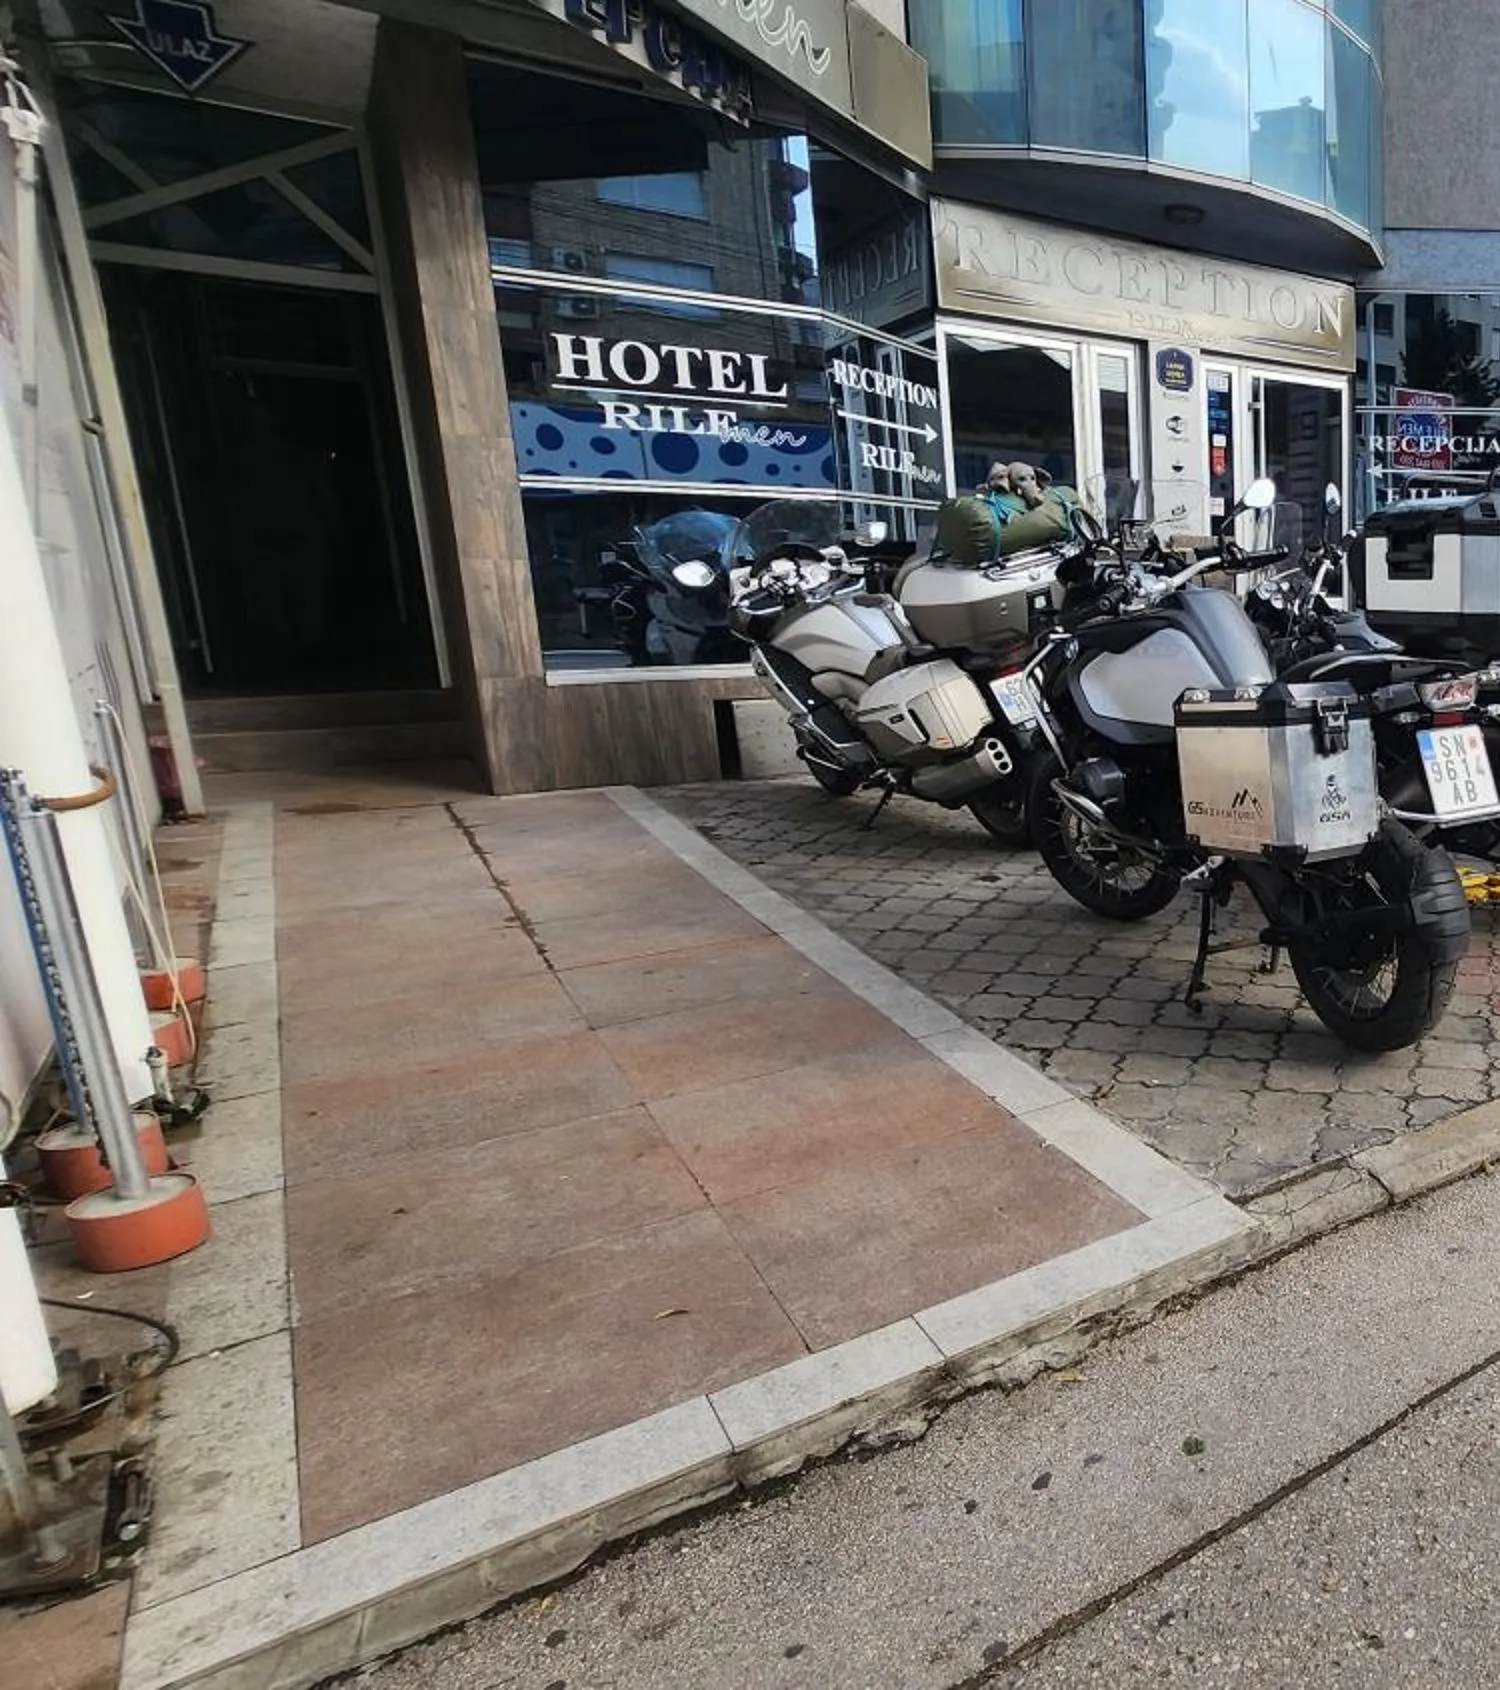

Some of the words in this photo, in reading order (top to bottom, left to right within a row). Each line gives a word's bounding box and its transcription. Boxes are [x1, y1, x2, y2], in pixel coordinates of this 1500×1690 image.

[943, 215, 1344, 338] RECEPTION
[551, 333, 787, 397] HOTEL
[832, 358, 938, 410] RECEPTION
[598, 401, 737, 435] RILE
[862, 441, 915, 473] RILE
